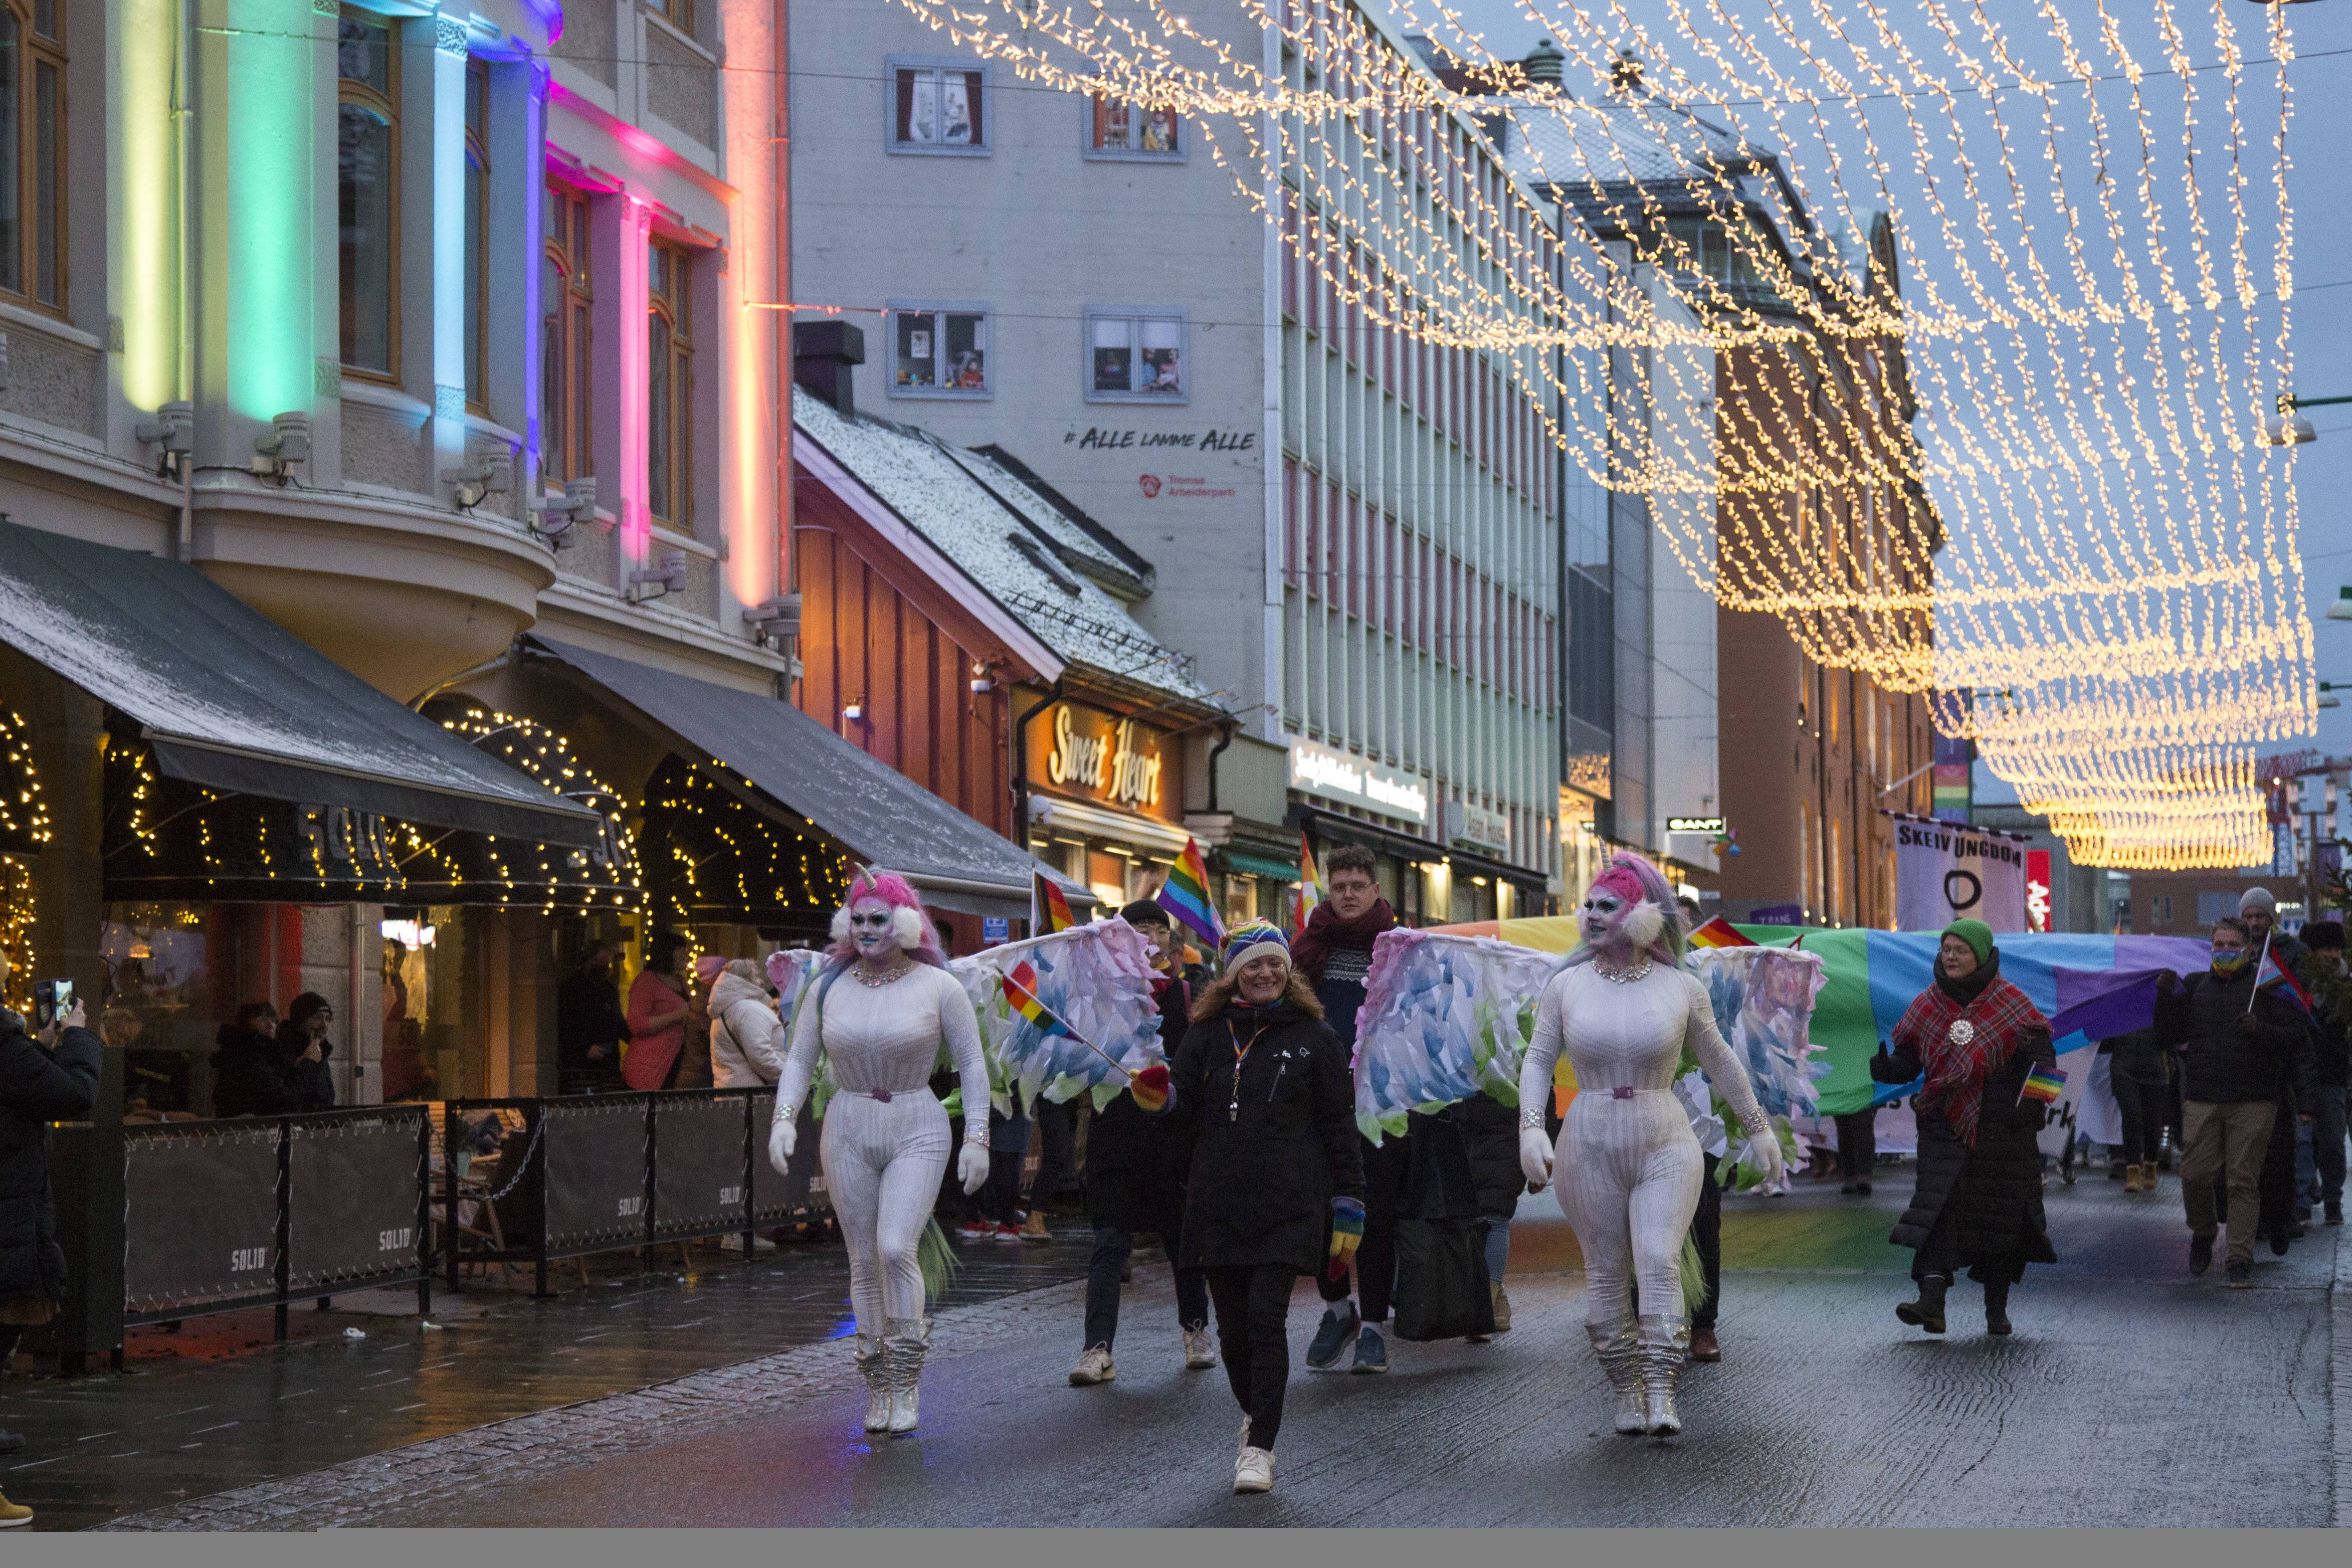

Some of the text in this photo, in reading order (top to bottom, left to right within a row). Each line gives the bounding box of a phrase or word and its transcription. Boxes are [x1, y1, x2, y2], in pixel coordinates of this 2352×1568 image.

[1200, 429, 1256, 451] ALLE
[1050, 705, 1161, 806] Sweet Heart
[1670, 819, 1721, 830] GANT
[1899, 825, 1951, 852] SKEIV
[2027, 879, 2050, 934] Ade
[379, 1228, 411, 1251] SOLID
[231, 1247, 266, 1271] SOLID
